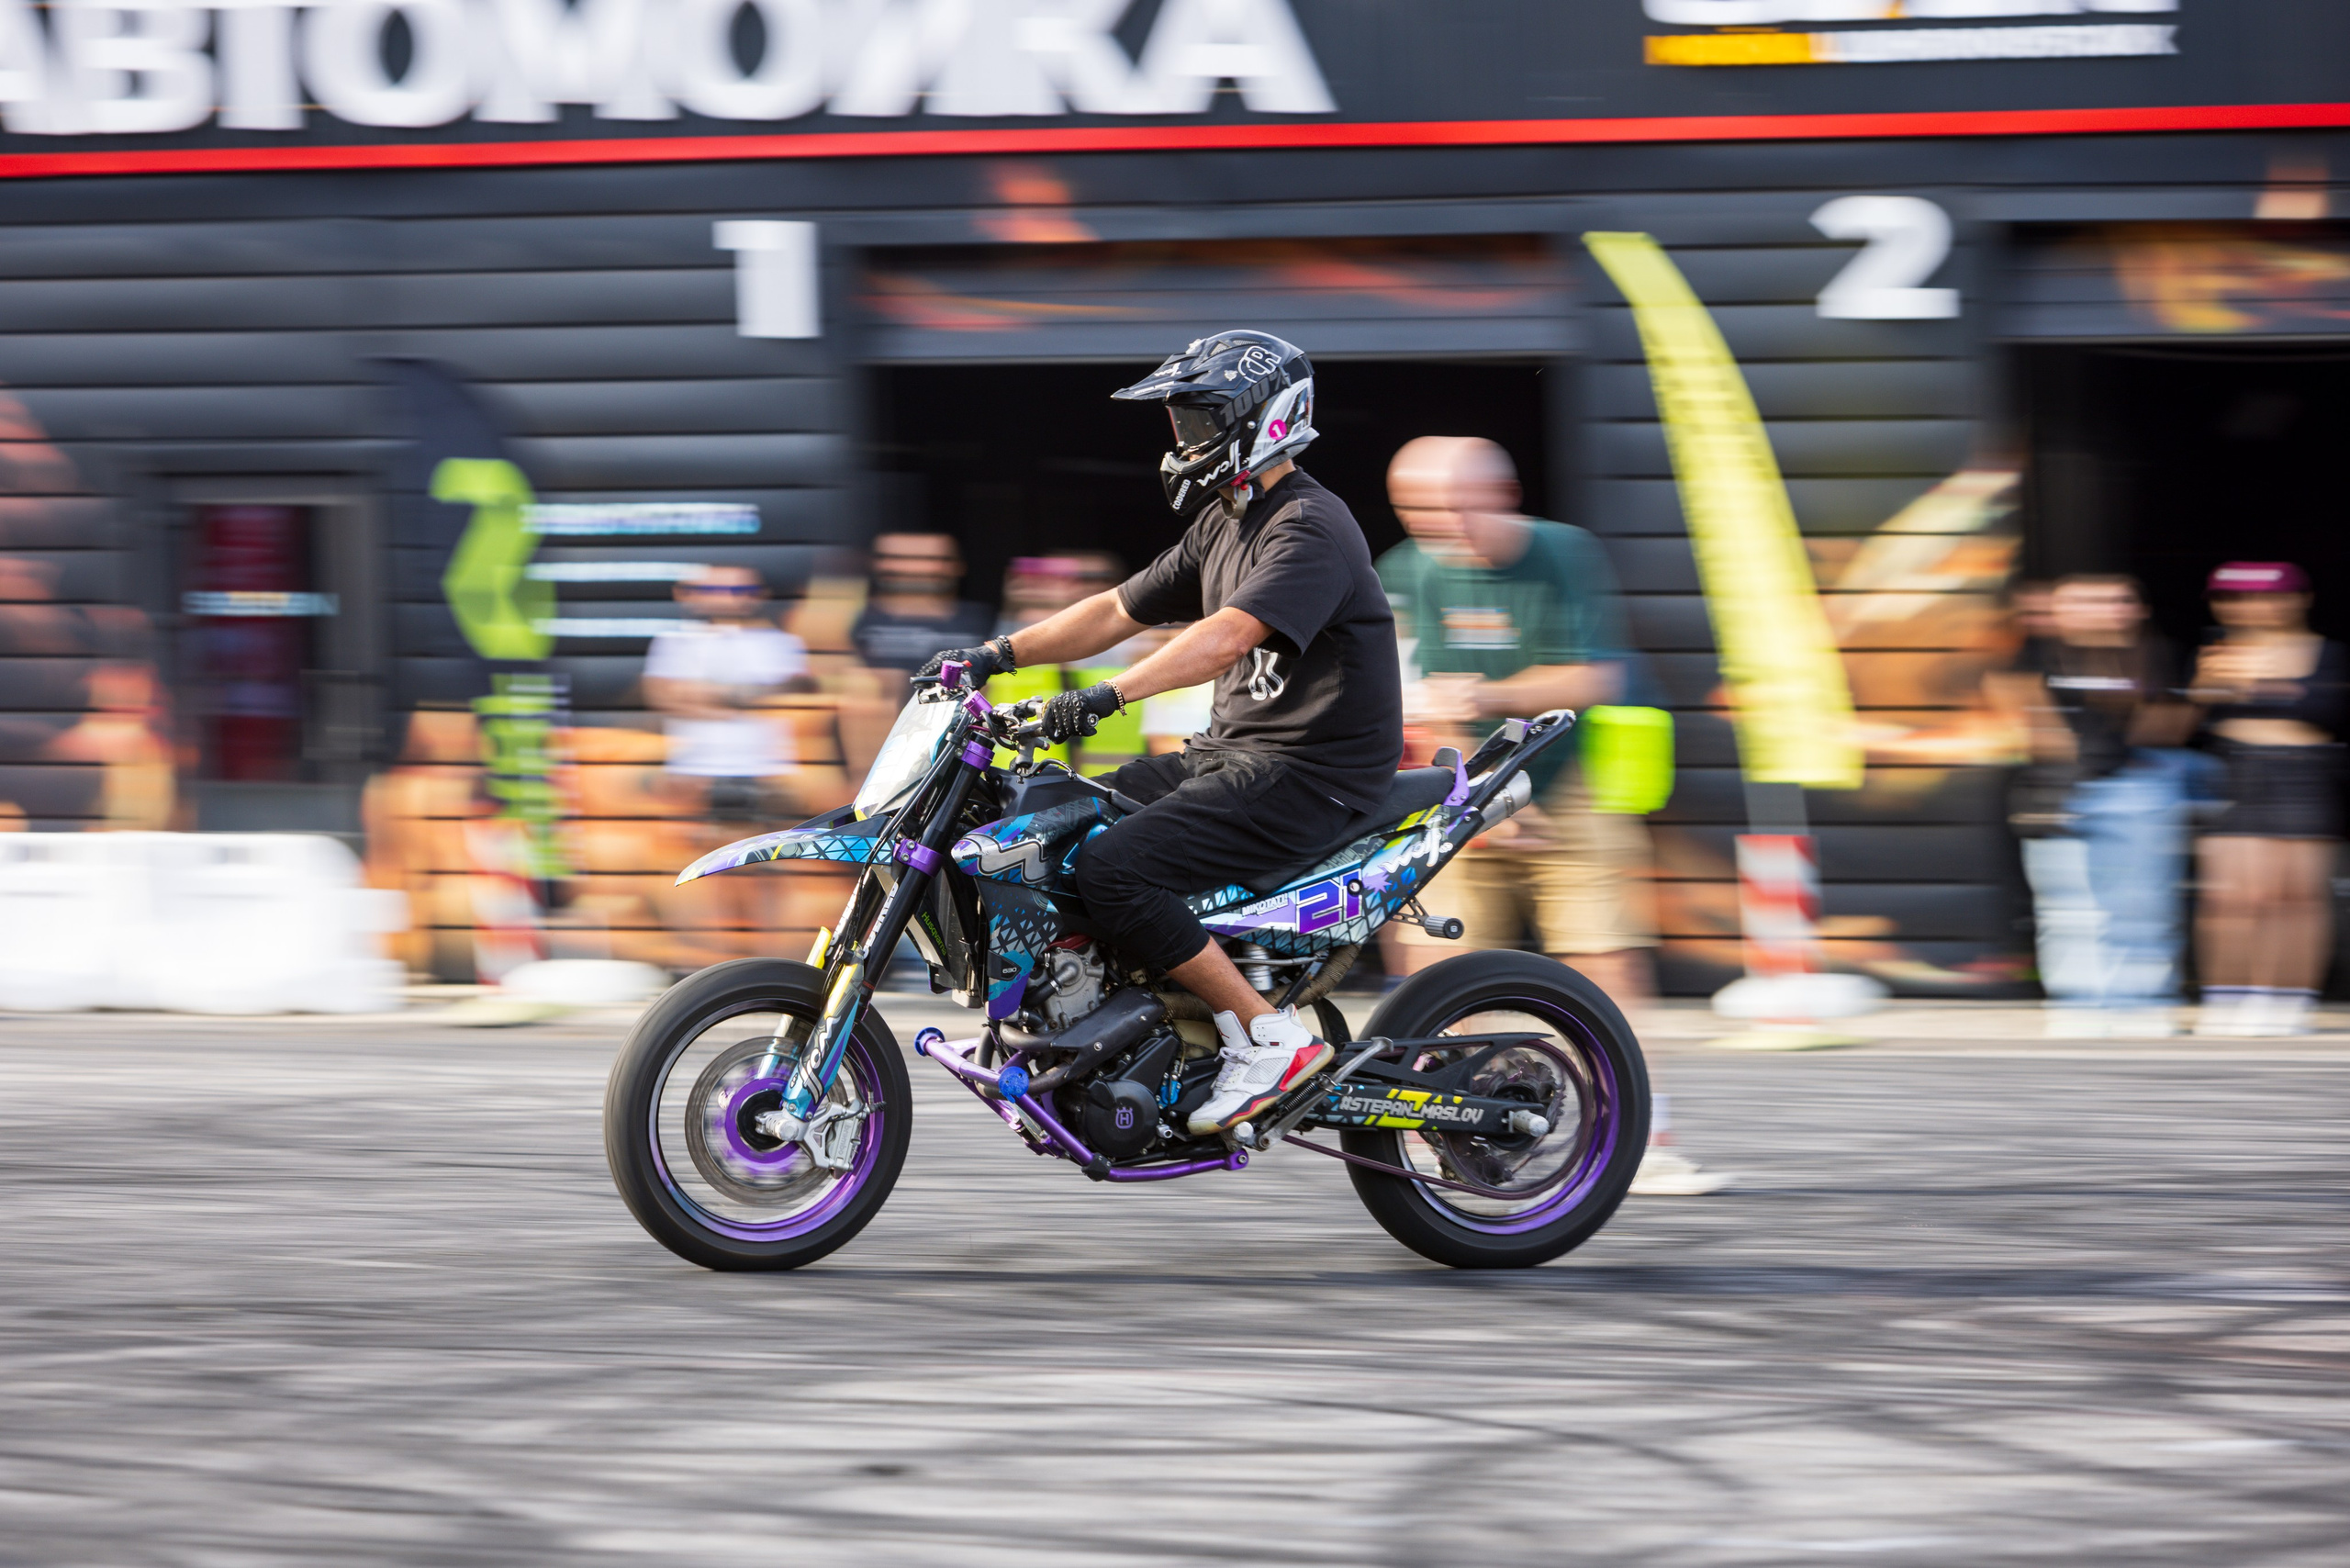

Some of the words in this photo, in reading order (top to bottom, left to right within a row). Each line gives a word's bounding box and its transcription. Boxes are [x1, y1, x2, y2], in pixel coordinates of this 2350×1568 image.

[712, 219, 821, 338] 1
[1807, 195, 1962, 319] 2
[1220, 369, 1290, 427] 100%
[1271, 424, 1282, 438] 1
[1196, 439, 1241, 487] wolf
[1172, 478, 1192, 510] CODERED
[1295, 868, 1363, 936] 21
[921, 911, 948, 956] Husqvarna
